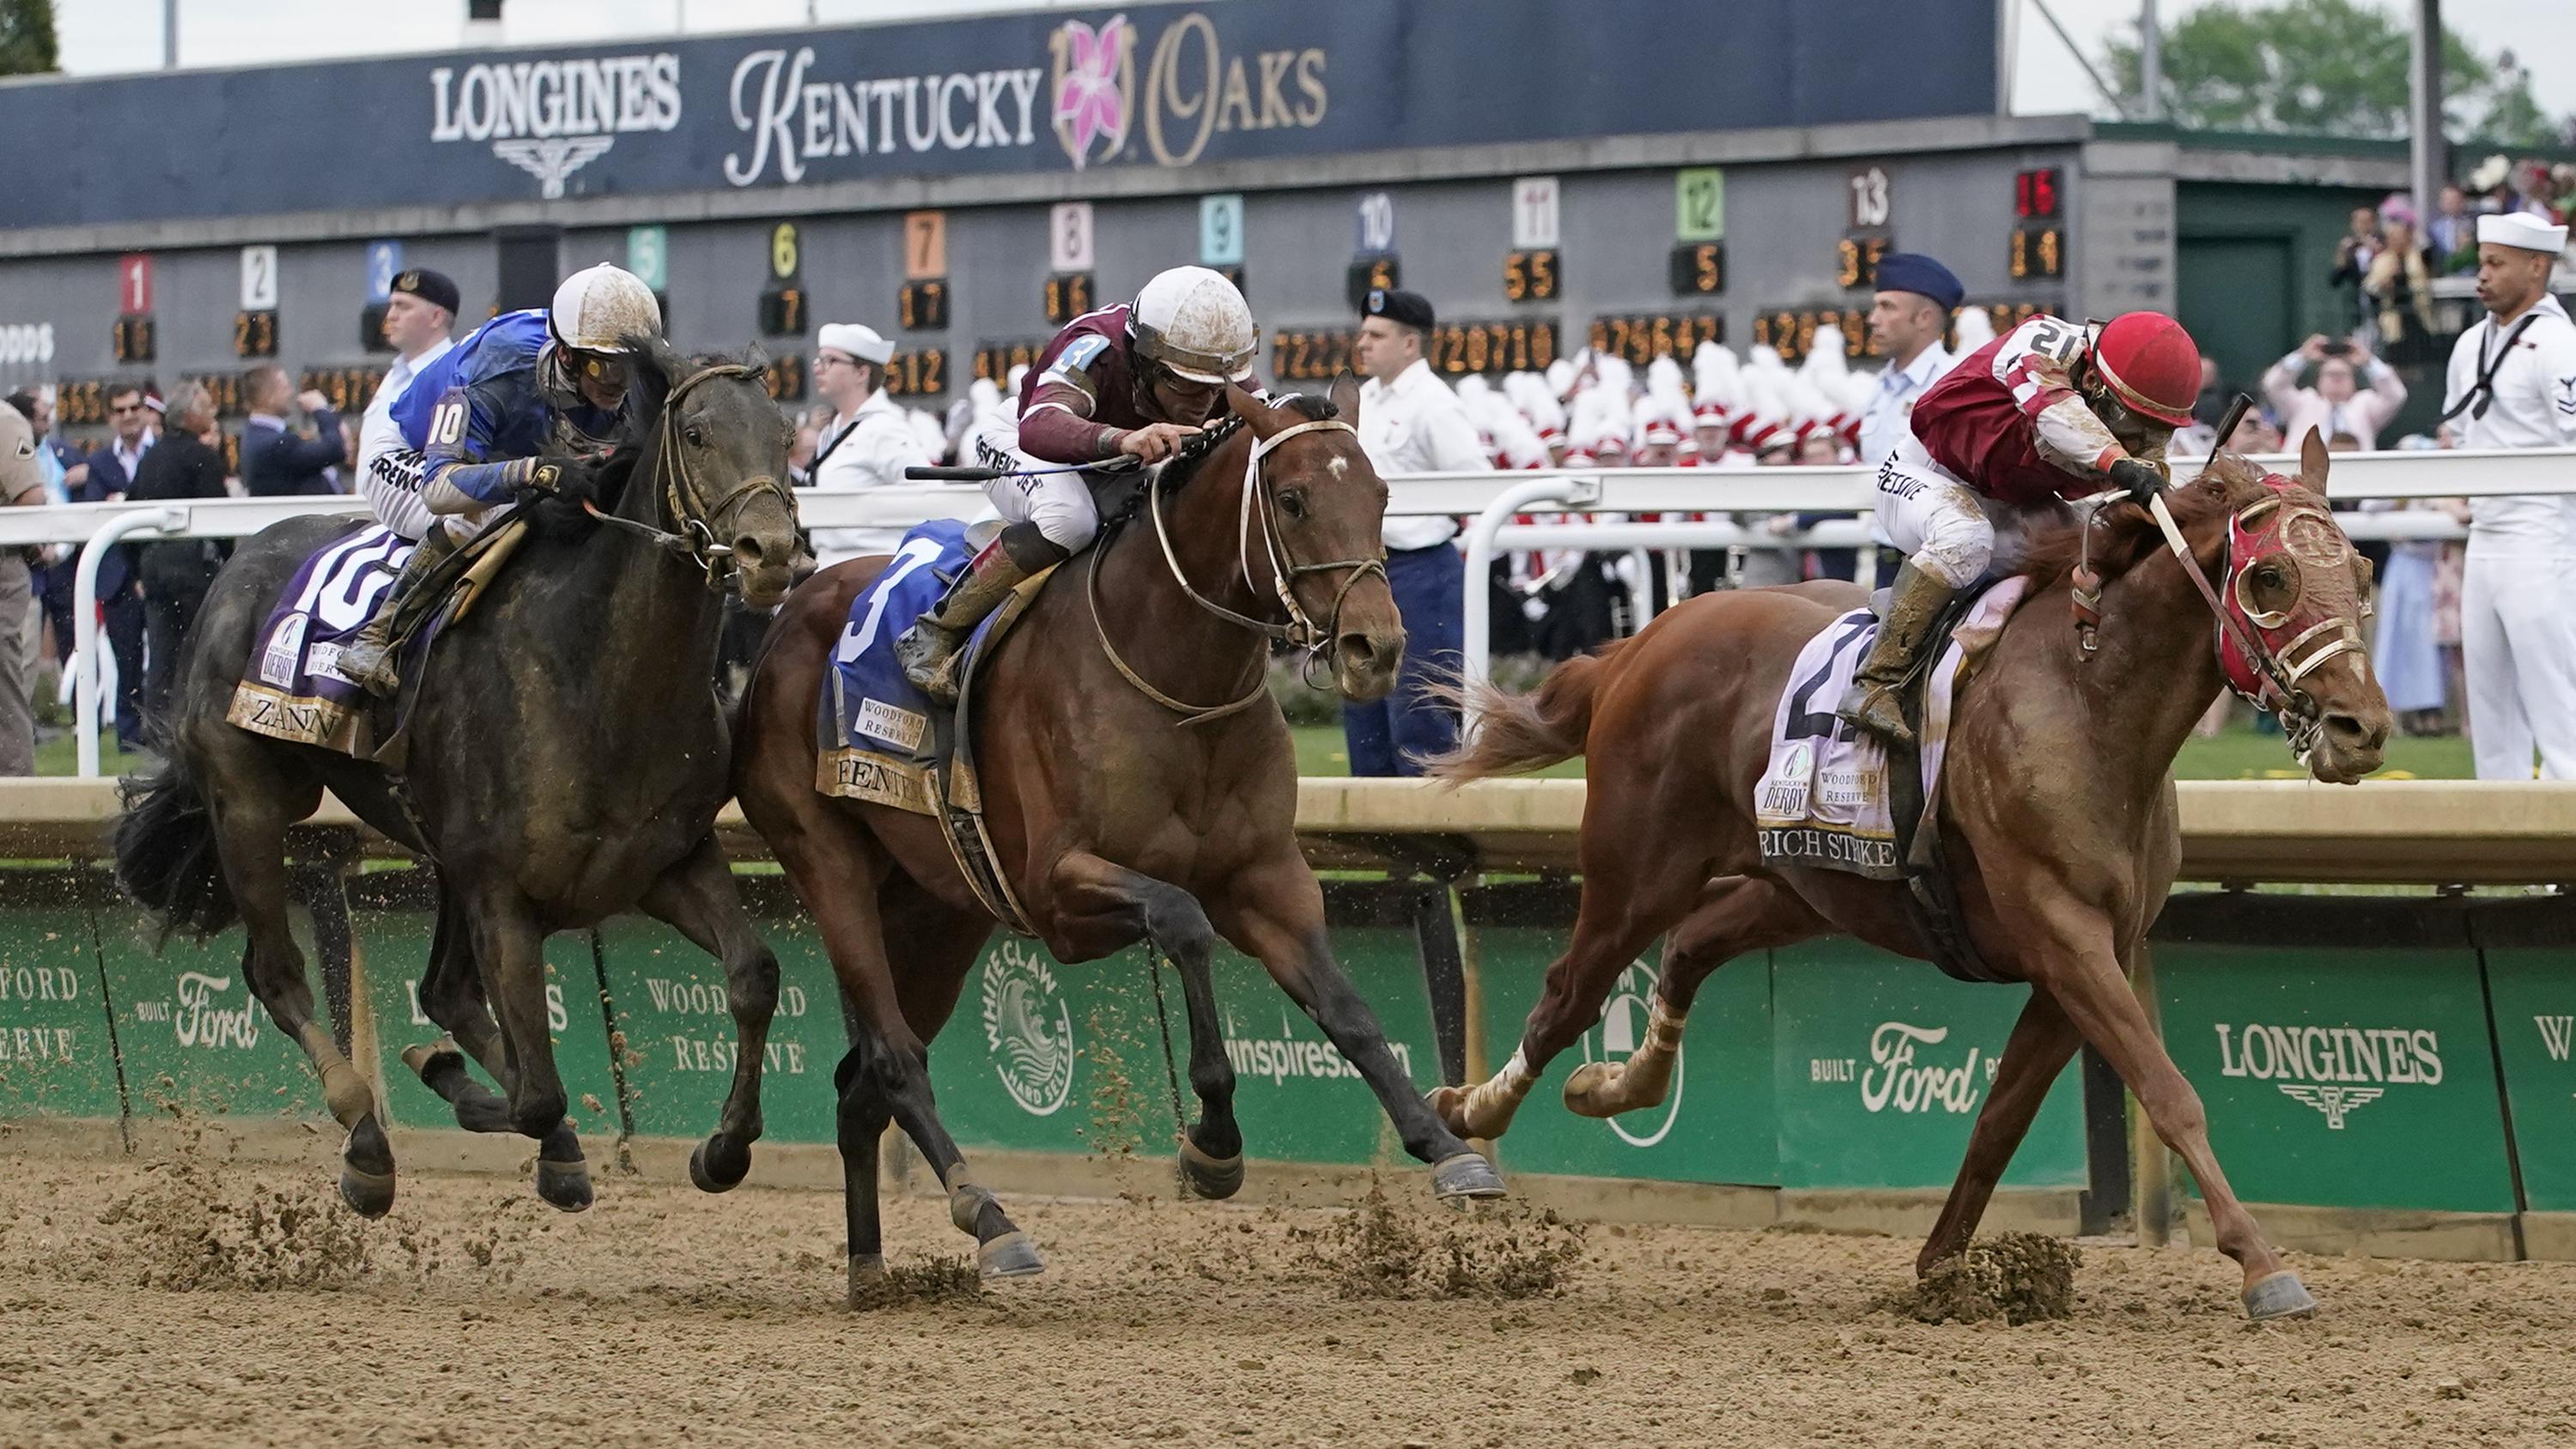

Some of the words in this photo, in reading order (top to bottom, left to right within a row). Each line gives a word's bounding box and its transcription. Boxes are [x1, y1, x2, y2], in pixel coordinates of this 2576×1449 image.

[431, 53, 682, 142] LONGINES
[724, 46, 1042, 187] KENTUCKY
[1144, 12, 1327, 167] OAKS
[1359, 192, 1393, 249] 10
[1686, 179, 1714, 229] 12
[1851, 167, 1888, 226] 13
[773, 222, 797, 277] 6
[918, 219, 935, 269] 7
[1064, 210, 1082, 259] 8
[1215, 201, 1231, 254] 9
[130, 260, 144, 311] 1
[254, 251, 267, 299] 2
[1697, 244, 1718, 291] 5
[1059, 336, 1099, 373] 3
[2030, 323, 2077, 364] 21
[428, 403, 465, 445] 10
[836, 537, 944, 663] 3
[264, 652, 295, 684] DERBY
[864, 700, 925, 729] WOODFORD
[1764, 787, 1807, 815] DERBY
[1821, 772, 1877, 785] WOODFORD
[1826, 790, 1869, 802] RESERVE
[1759, 830, 1823, 857] RICH
[137, 1002, 170, 1022] BUILT
[175, 971, 259, 1050] Ford
[982, 949, 1005, 1053] WHITE
[1003, 940, 1058, 995] CLAW
[1811, 1058, 1855, 1082] BUILT
[1861, 1021, 1980, 1114] Ford
[2215, 1023, 2443, 1086] LONGINES
[1007, 1068, 1042, 1106] HARD
